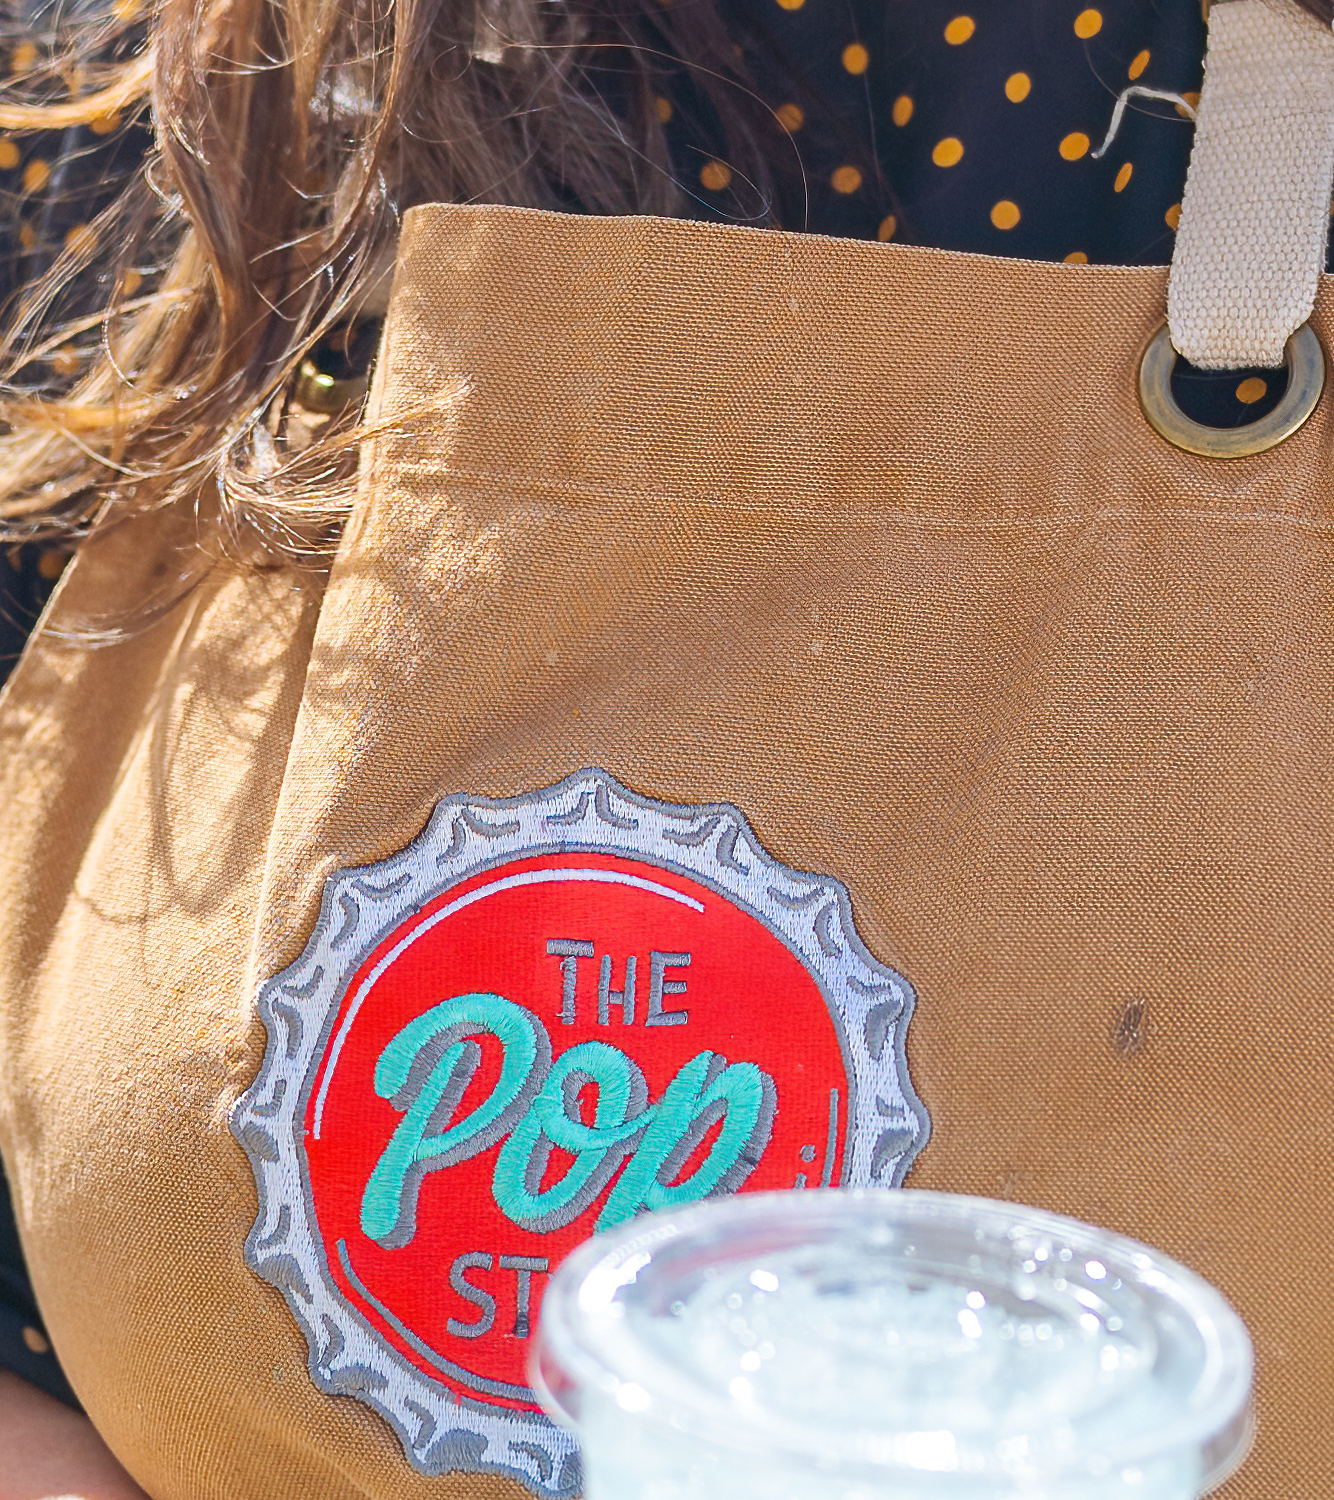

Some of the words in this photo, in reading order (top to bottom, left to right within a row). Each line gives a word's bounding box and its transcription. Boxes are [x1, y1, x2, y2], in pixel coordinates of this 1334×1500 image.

[546, 938, 691, 1026] THE
[359, 991, 778, 1251] Pop
[446, 1250, 551, 1339] ST
